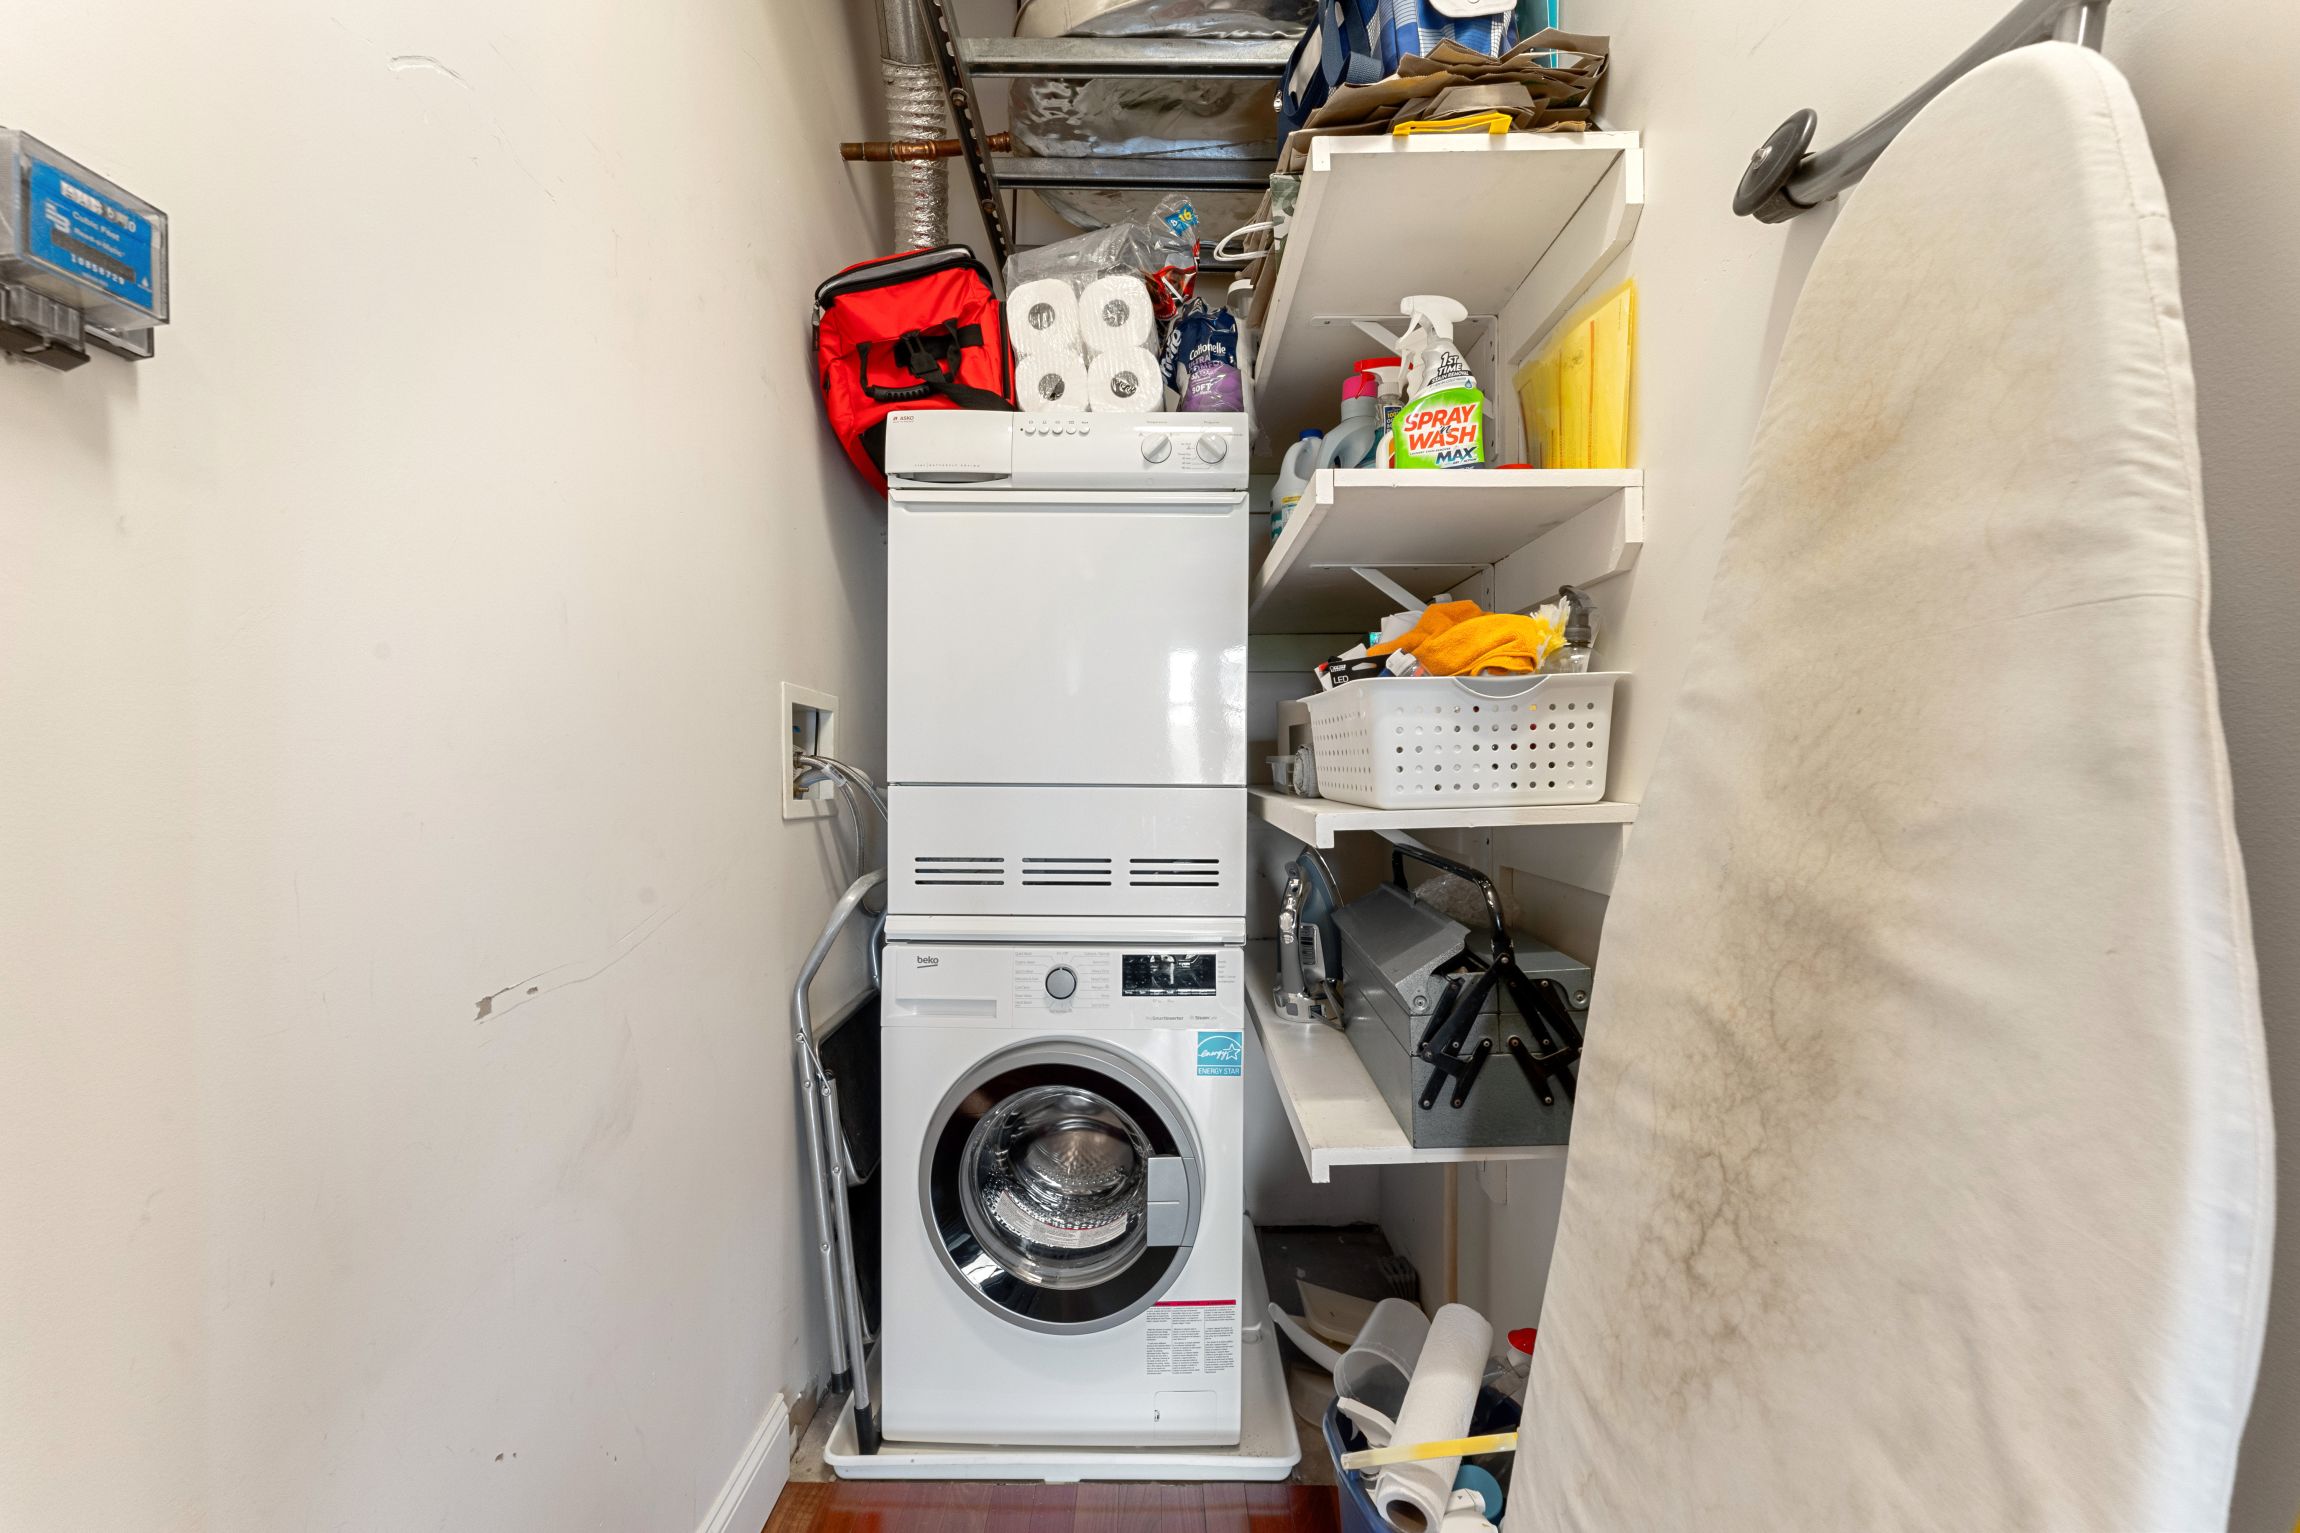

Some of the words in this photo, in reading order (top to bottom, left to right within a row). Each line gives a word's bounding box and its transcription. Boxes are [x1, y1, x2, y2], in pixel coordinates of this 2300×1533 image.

[1178, 208, 1192, 222] 16
[1189, 341, 1227, 361] Cottonelle
[1188, 354, 1211, 368] ULTRA
[1441, 351, 1459, 366] 1ST
[1438, 363, 1462, 376] TIME
[1192, 383, 1212, 394] SOFT
[1404, 403, 1477, 432] SPRAY
[1409, 424, 1477, 451] WASH
[1435, 446, 1477, 464] MAX
[1333, 675, 1349, 684] LED
[917, 955, 939, 964] beko
[1198, 1067, 1222, 1075] ENERGY
[1223, 1067, 1240, 1075] STAR
